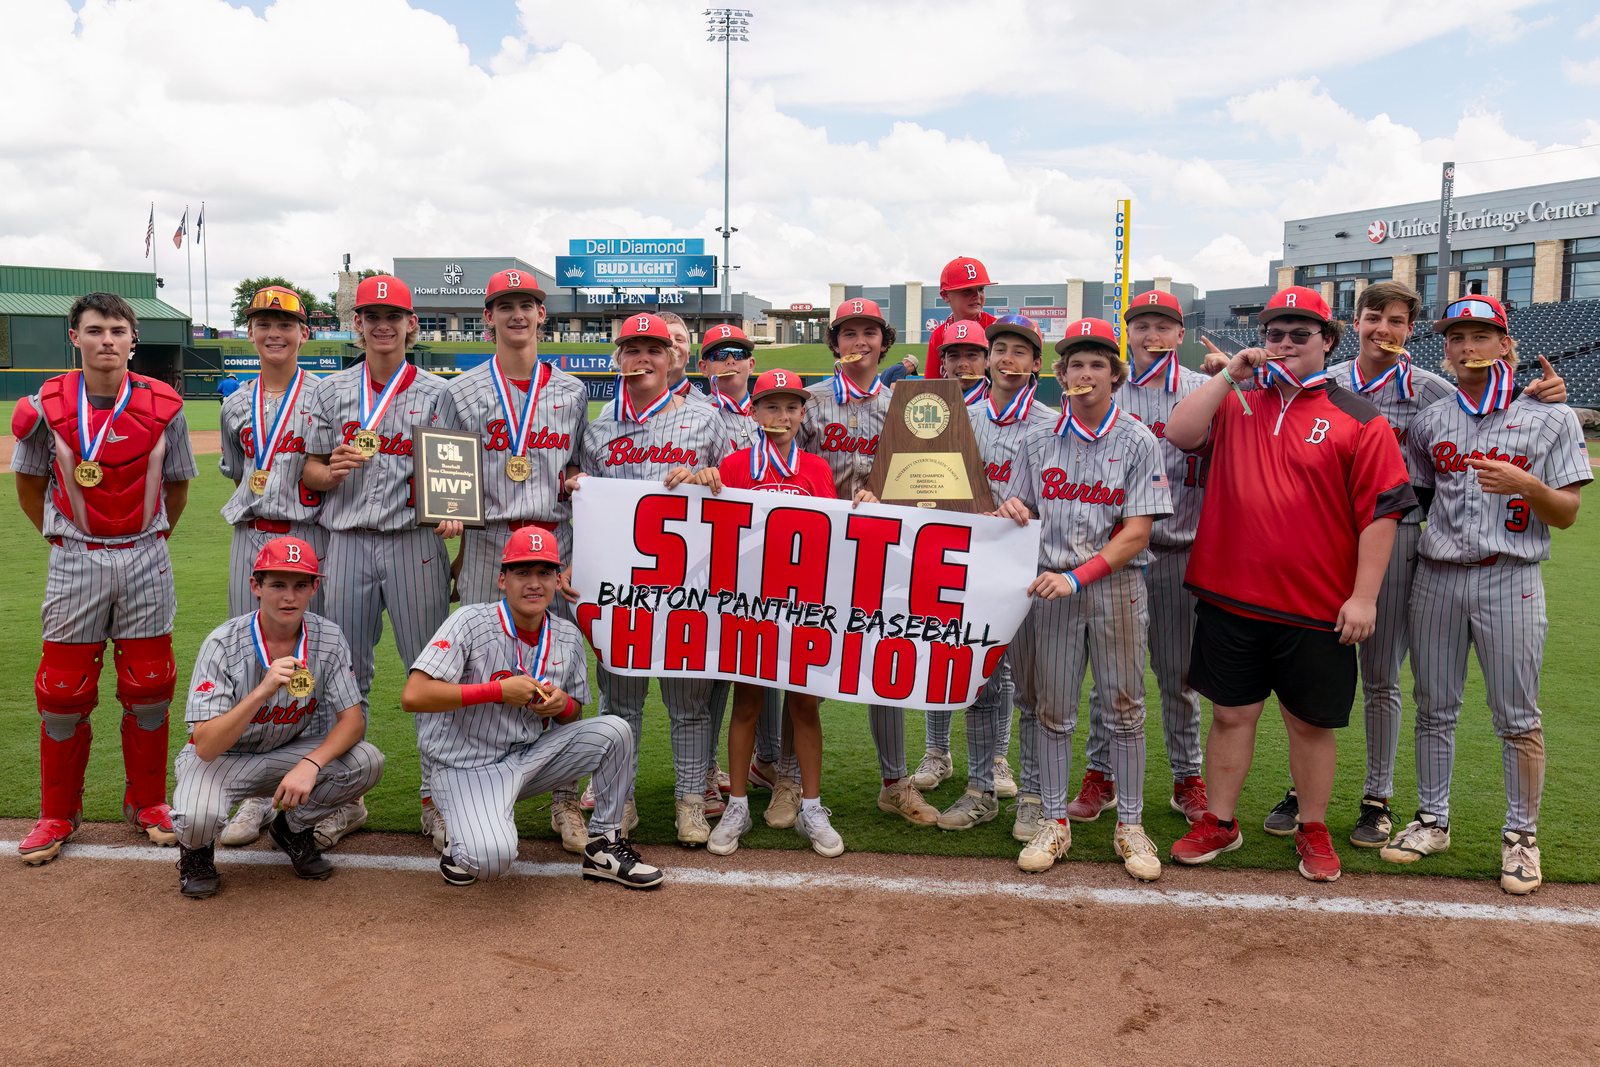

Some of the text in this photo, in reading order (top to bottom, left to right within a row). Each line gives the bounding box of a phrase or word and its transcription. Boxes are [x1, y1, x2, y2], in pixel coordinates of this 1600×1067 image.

[1387, 201, 1600, 239] United Heritage Center
[586, 239, 686, 254] Dell Diamond
[1115, 212, 1124, 264] CODY
[597, 263, 674, 275] BUD LIGHT
[963, 263, 977, 280] B
[506, 271, 521, 288] B
[376, 281, 388, 299] B
[414, 287, 488, 295] HOME RUN DUGOU
[587, 293, 684, 304] BULLPEN BAR
[851, 300, 864, 315] B
[1114, 273, 1122, 337] POOLS
[636, 316, 650, 332] B
[718, 326, 732, 339] B
[955, 324, 968, 339] B
[773, 372, 788, 388] B
[913, 402, 941, 423] UIL
[820, 422, 880, 455] Burt
[1304, 417, 1331, 444] B
[437, 441, 463, 462] UIL
[605, 436, 698, 467] Burton
[440, 469, 474, 477] Championships
[430, 477, 472, 494] MVP
[1042, 467, 1125, 506] Burton
[1504, 498, 1530, 533] 3
[528, 534, 543, 552] B
[285, 544, 301, 563] B
[631, 494, 972, 629] STATE
[598, 581, 1001, 649] BURTON PANTHER BASEBALL
